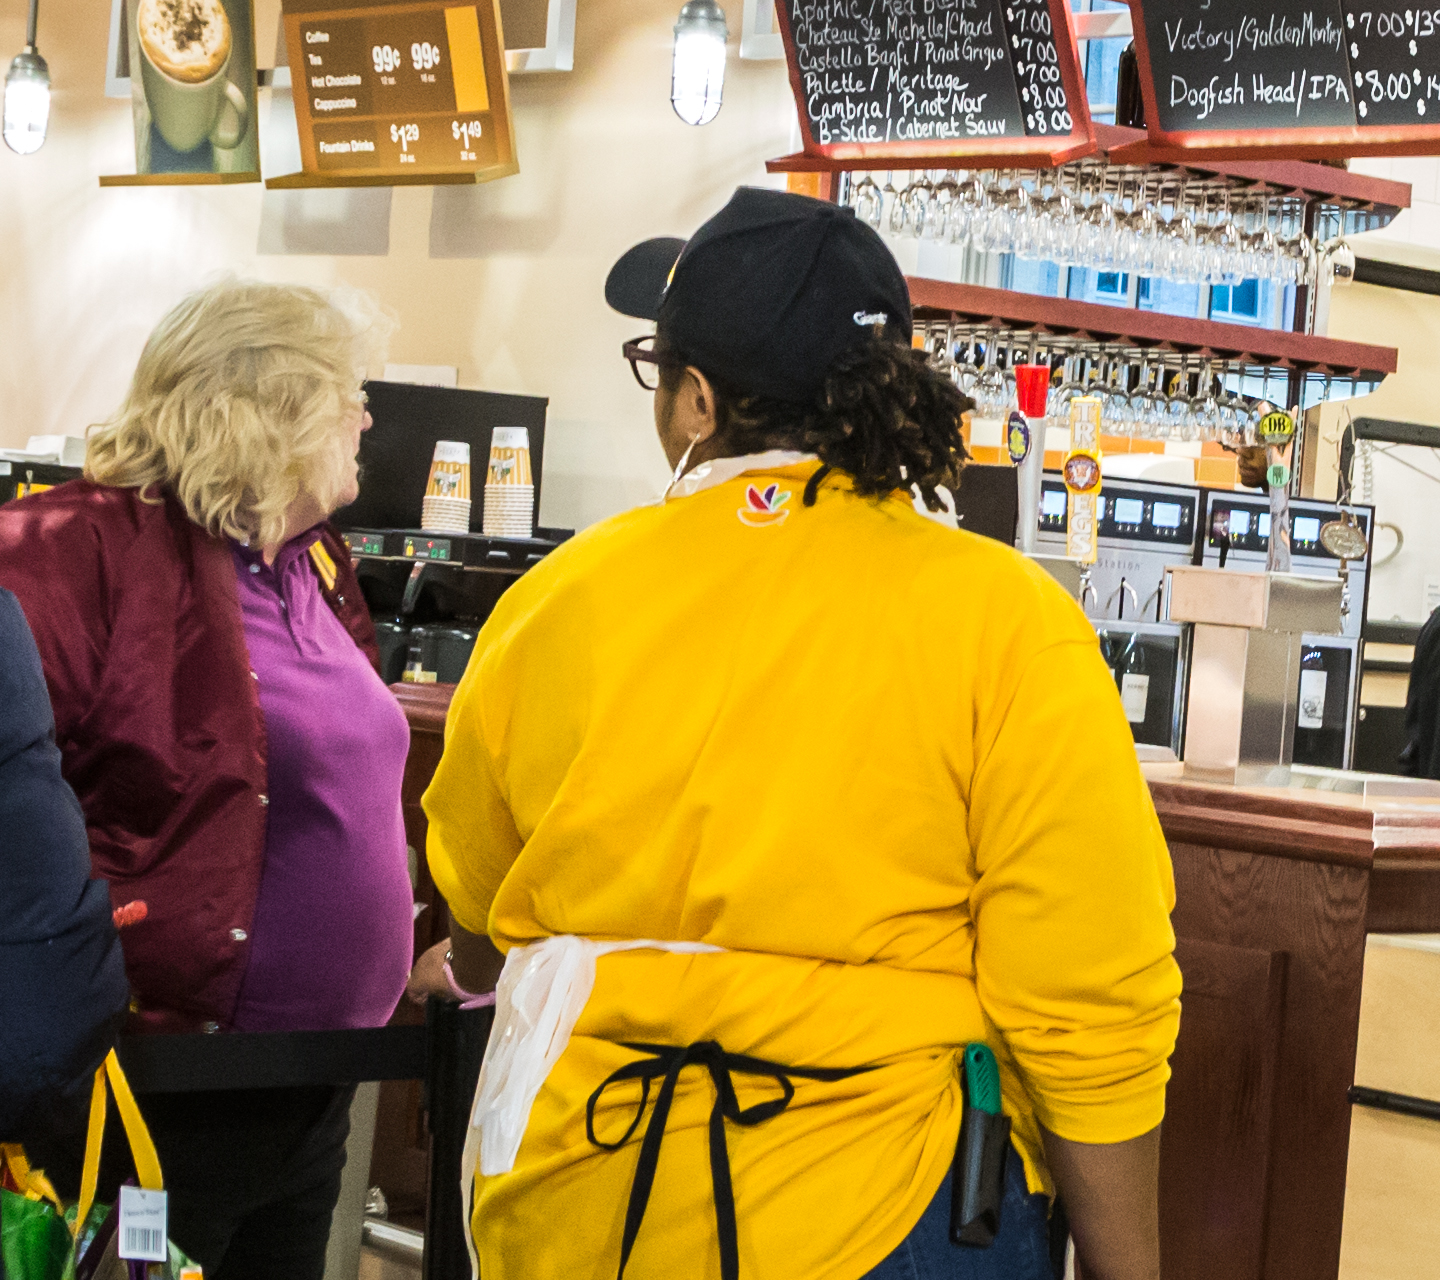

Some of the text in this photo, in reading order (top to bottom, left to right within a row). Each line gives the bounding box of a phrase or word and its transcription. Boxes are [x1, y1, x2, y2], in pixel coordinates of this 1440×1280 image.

[306, 31, 330, 44] Coffee
[372, 42, 440, 73] 99¢ 99¢
[799, 45, 862, 71] Castello
[924, 41, 960, 64] Pinot
[804, 65, 969, 100] Palette Meritage
[1170, 74, 1245, 119] Dogfish
[808, 94, 881, 122] Cambria
[899, 92, 945, 119] Pinot
[818, 114, 1006, 145] B-Side Cabernet Sauv
[1268, 417, 1286, 432] DB
